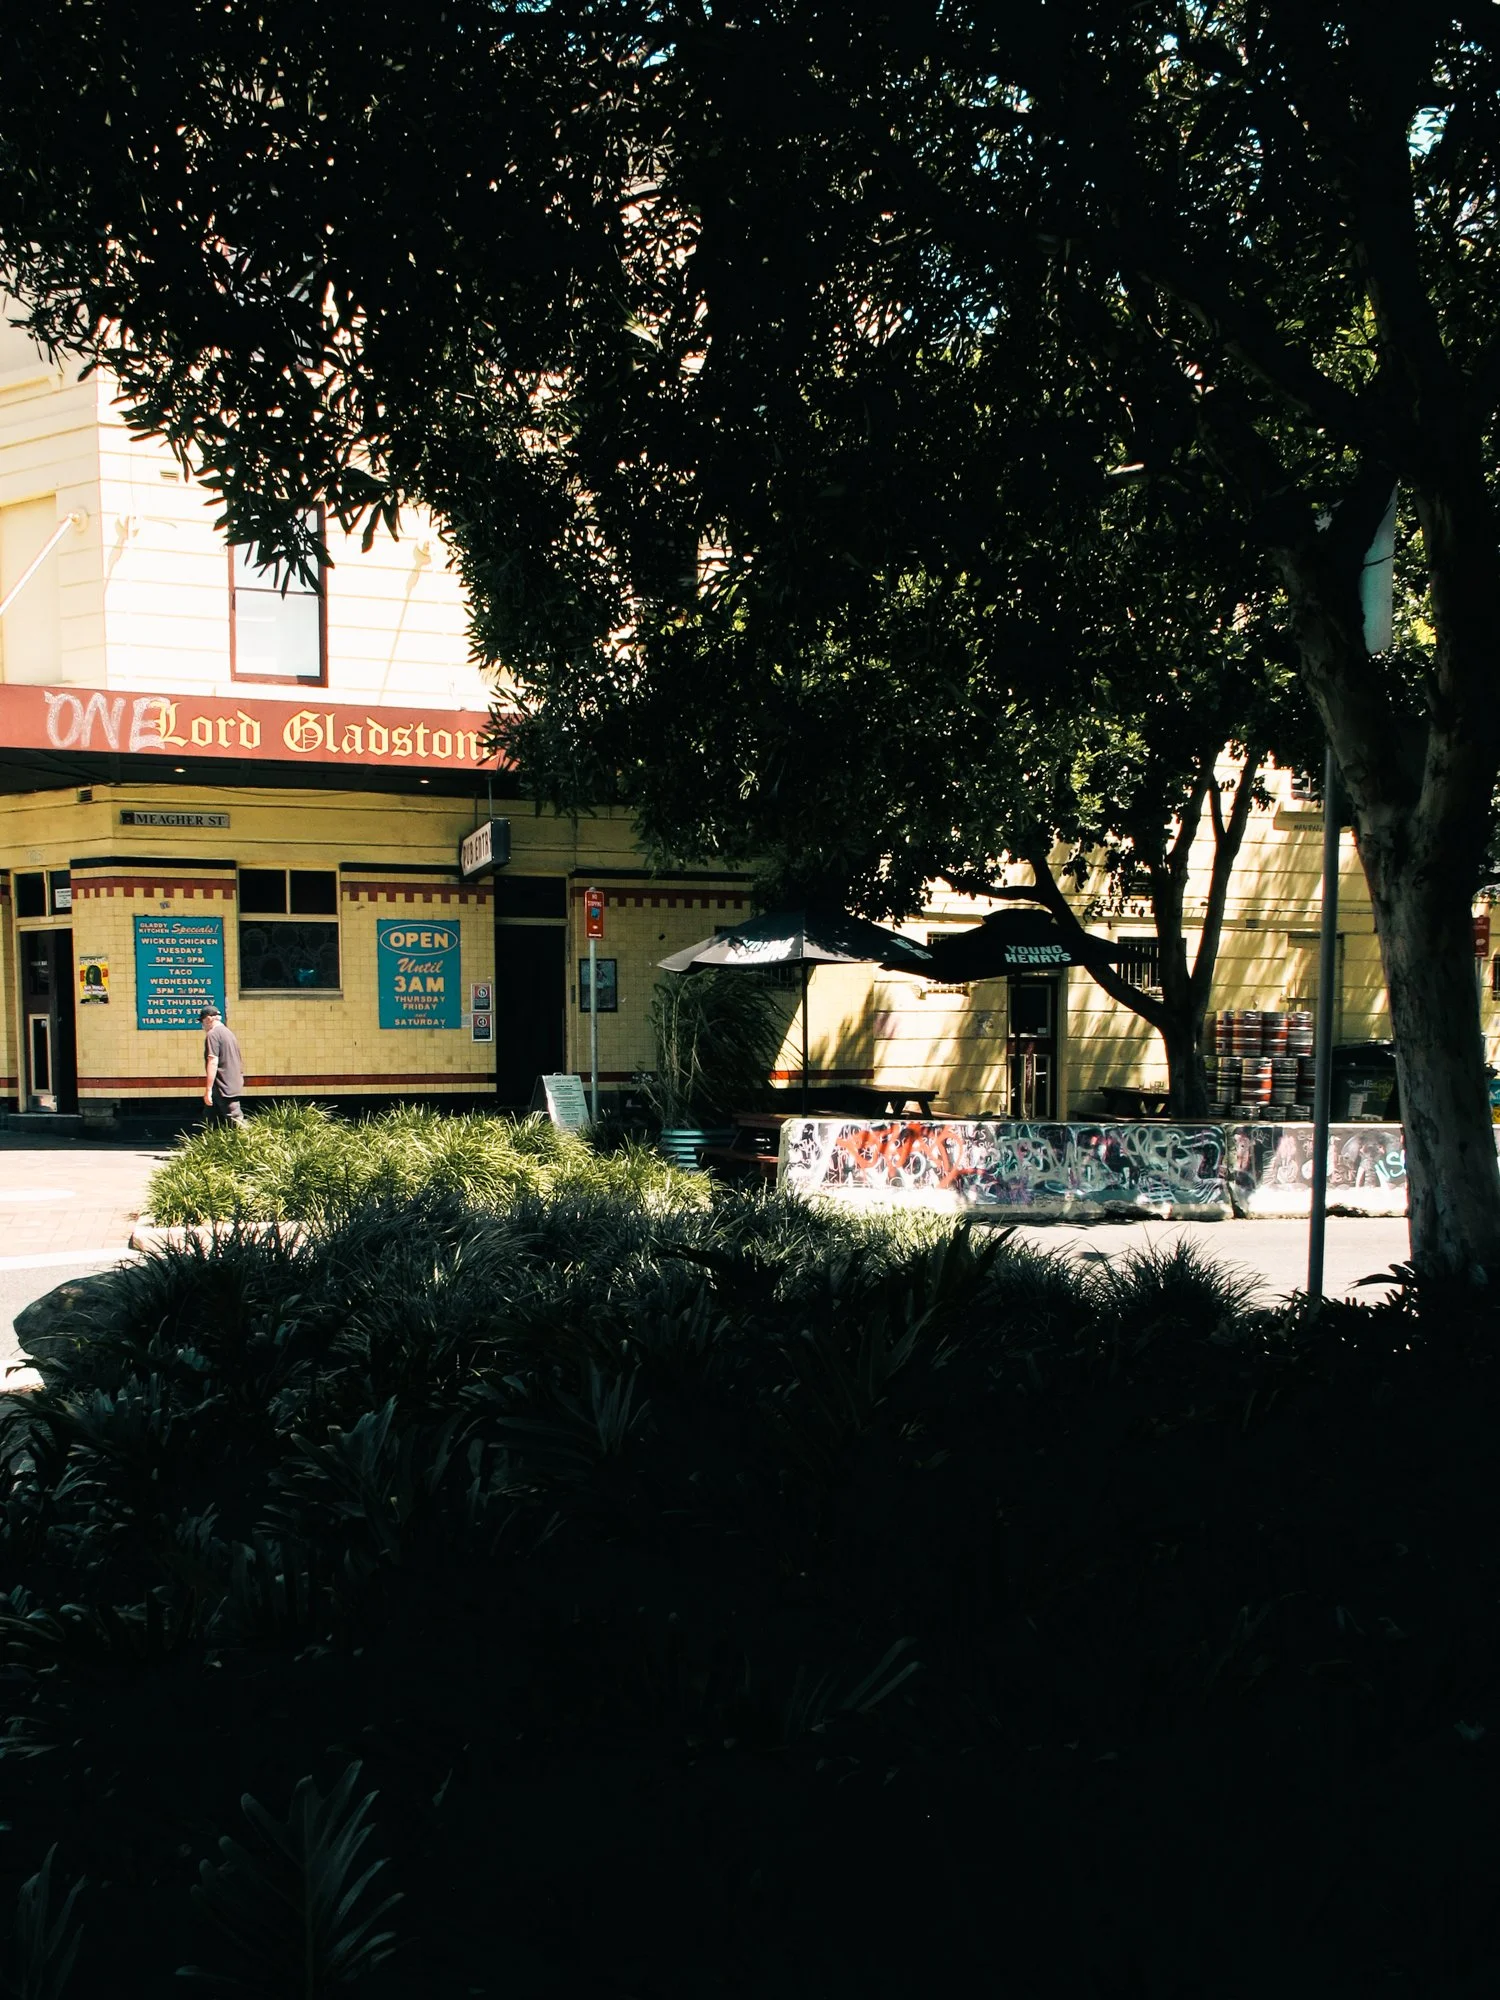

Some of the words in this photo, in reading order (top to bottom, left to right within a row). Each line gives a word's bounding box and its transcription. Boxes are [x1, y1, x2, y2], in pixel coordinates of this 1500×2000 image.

[44, 690, 171, 752] ONE
[149, 700, 262, 750] Lord
[136, 813, 204, 825] MEAGHER
[208, 815, 225, 826] ST
[462, 841, 473, 869] PUB
[475, 829, 491, 861] ENTR
[389, 932, 449, 948] OPEN
[1006, 944, 1064, 955] YOUNG
[397, 958, 443, 974] Until
[1004, 953, 1072, 963] HENRYS
[394, 976, 445, 993] 3AM
[403, 1003, 437, 1011] FRIDAY
[394, 1018, 446, 1026] SATURDAY
